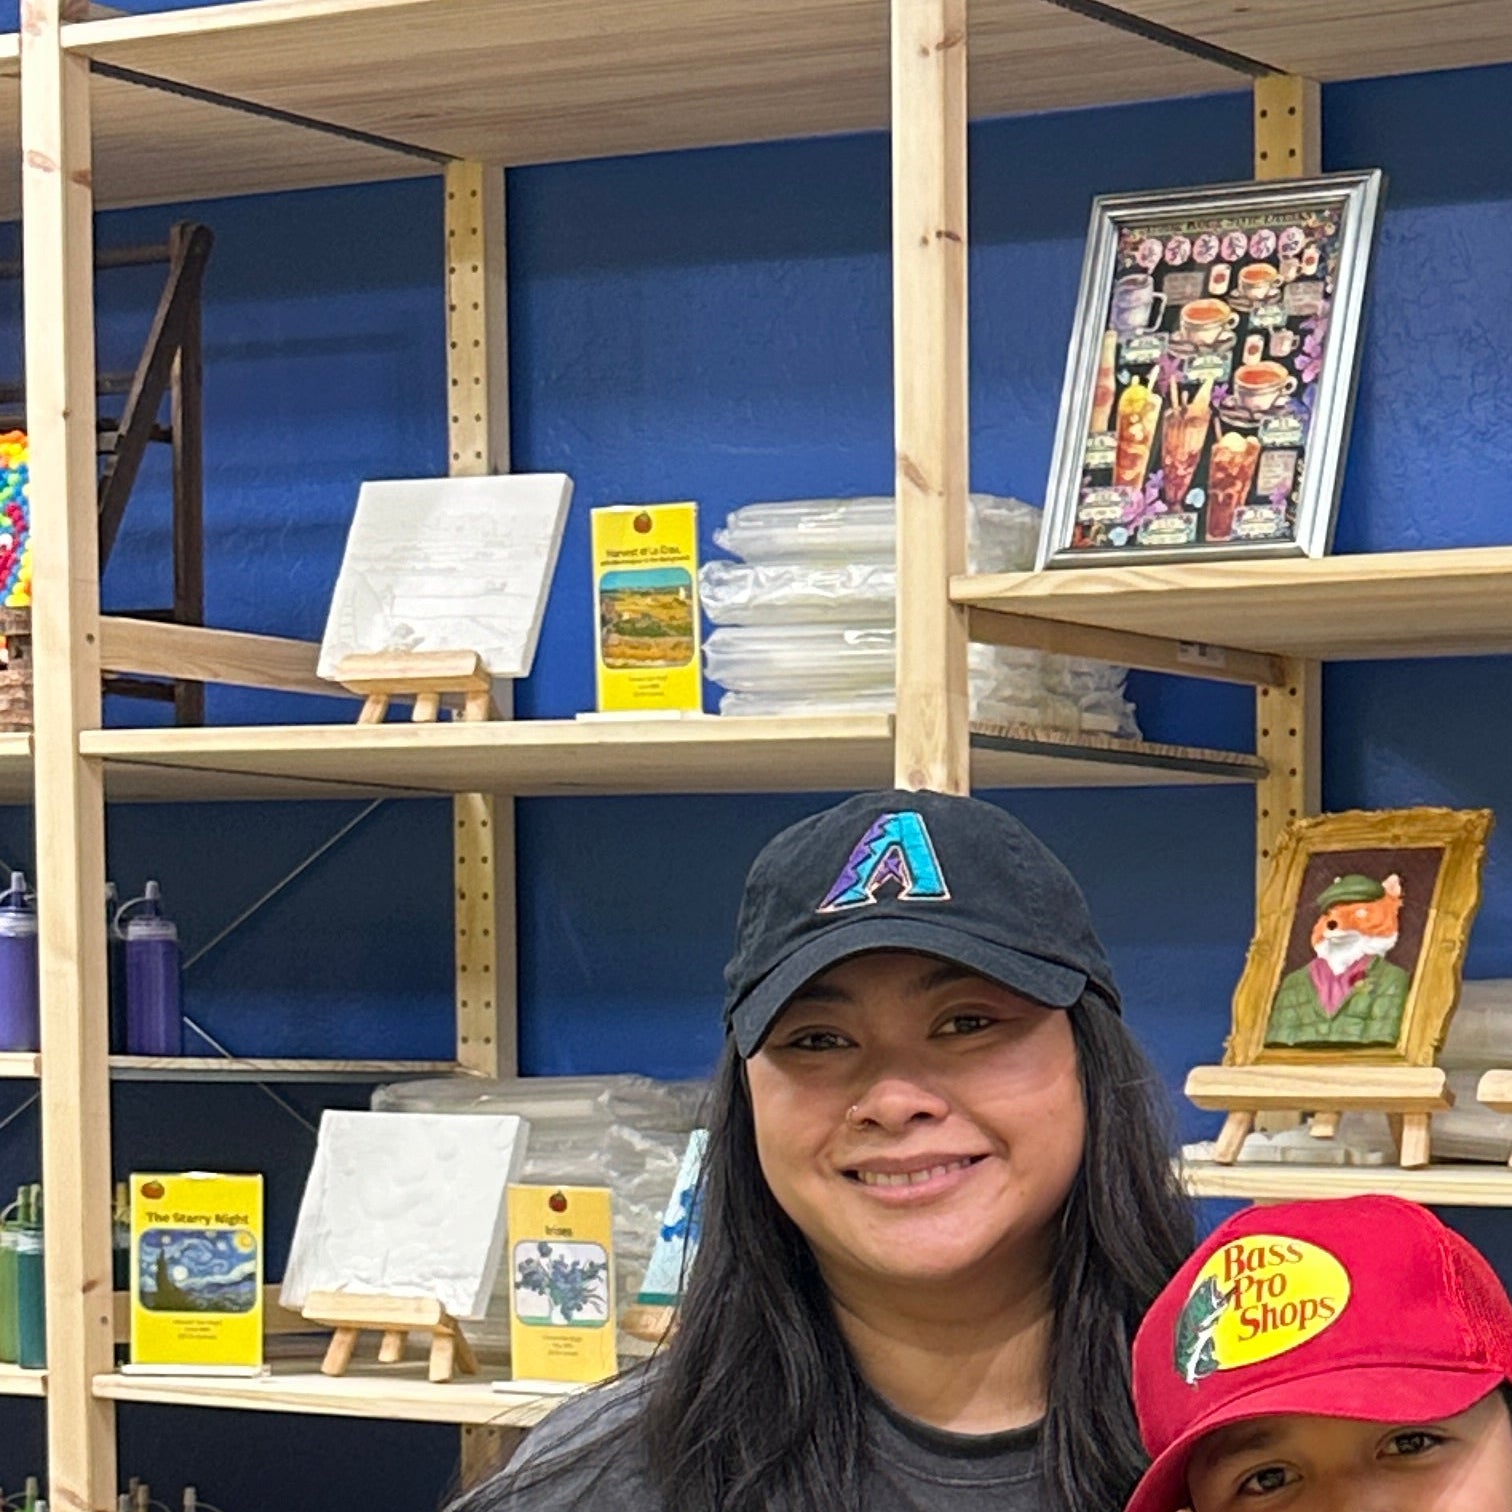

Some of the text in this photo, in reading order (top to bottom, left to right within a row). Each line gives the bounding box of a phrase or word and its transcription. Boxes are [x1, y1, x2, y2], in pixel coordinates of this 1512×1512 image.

[145, 1211, 249, 1226] The Starry Night
[1223, 1243, 1304, 1283] Bass
[1233, 1273, 1288, 1311] Pro
[1238, 1296, 1336, 1342] Shops
